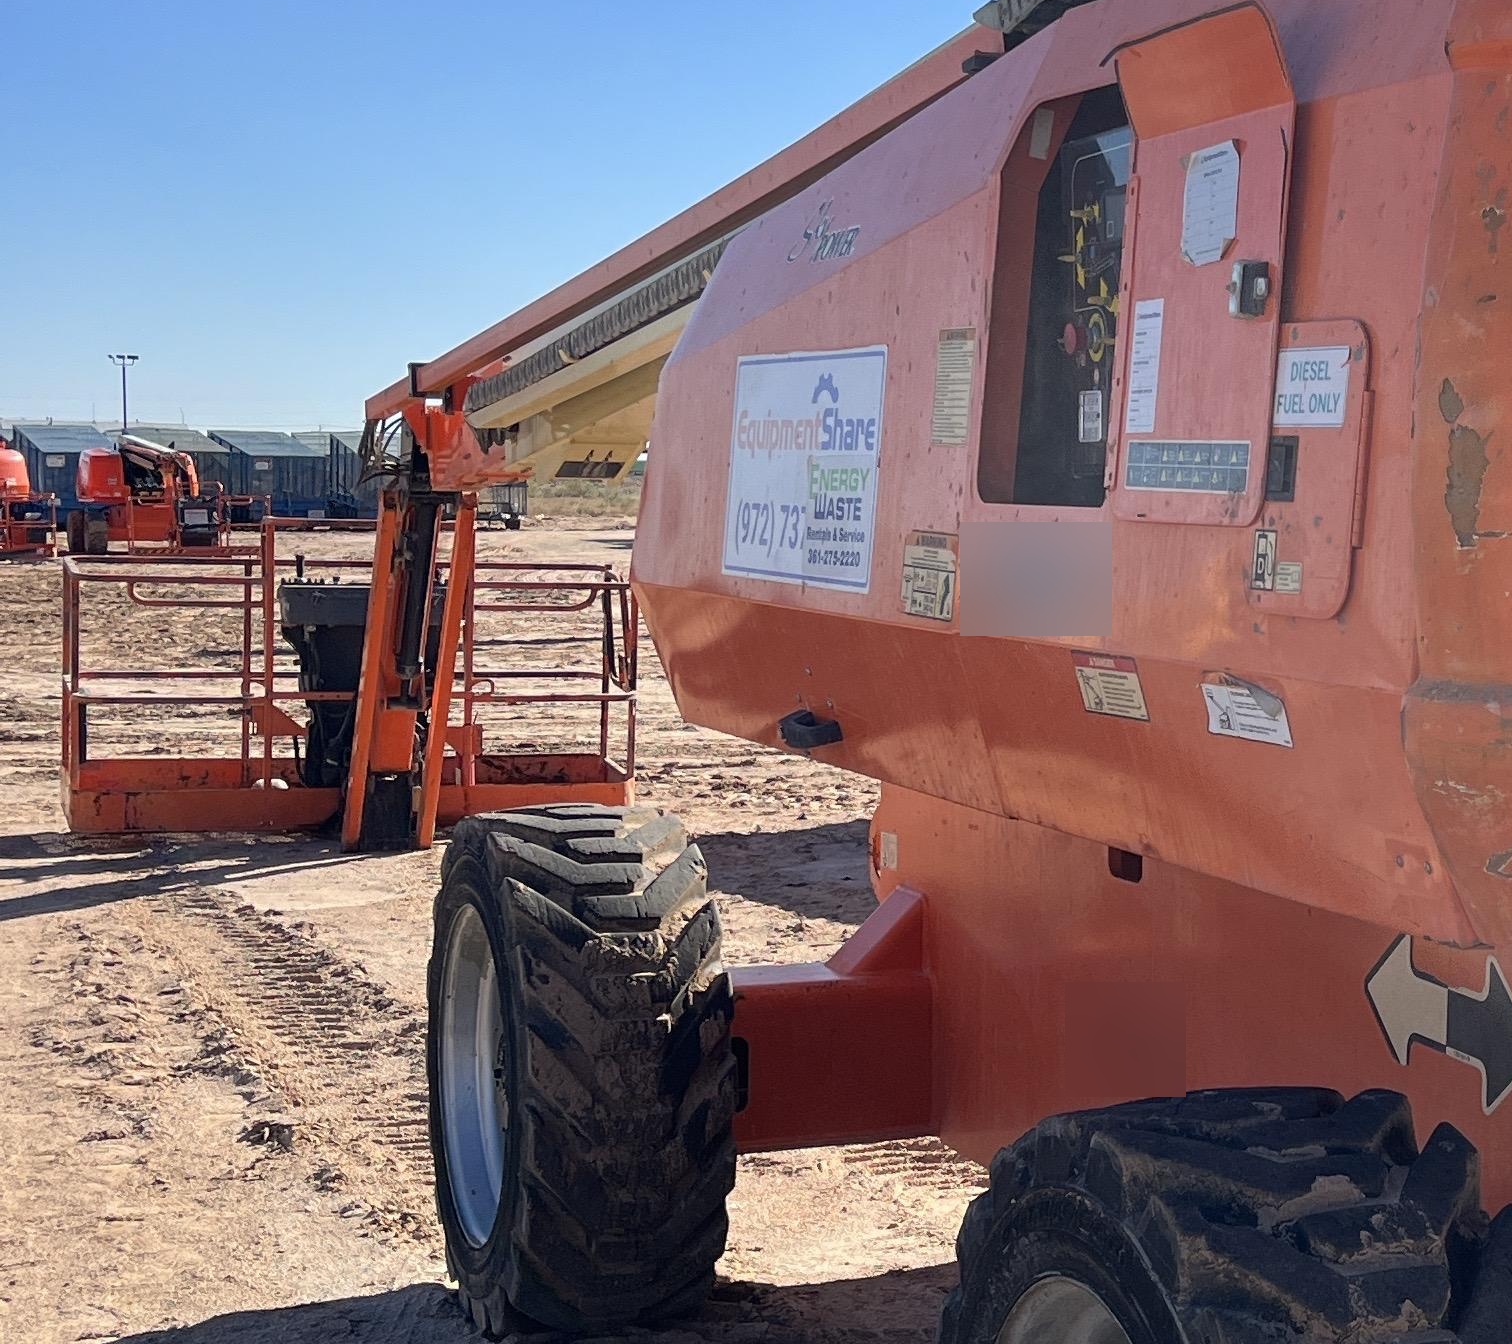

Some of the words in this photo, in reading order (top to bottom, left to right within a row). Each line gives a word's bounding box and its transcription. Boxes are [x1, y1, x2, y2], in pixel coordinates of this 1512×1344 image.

[1290, 360, 1332, 382] DIESEL
[1276, 393, 1305, 415] FUEL
[1308, 392, 1341, 414] ONLY
[737, 408, 876, 461] EquipmentShare
[810, 464, 870, 500] ENERGY
[814, 493, 863, 521] WASTE
[735, 498, 775, 559] (972)
